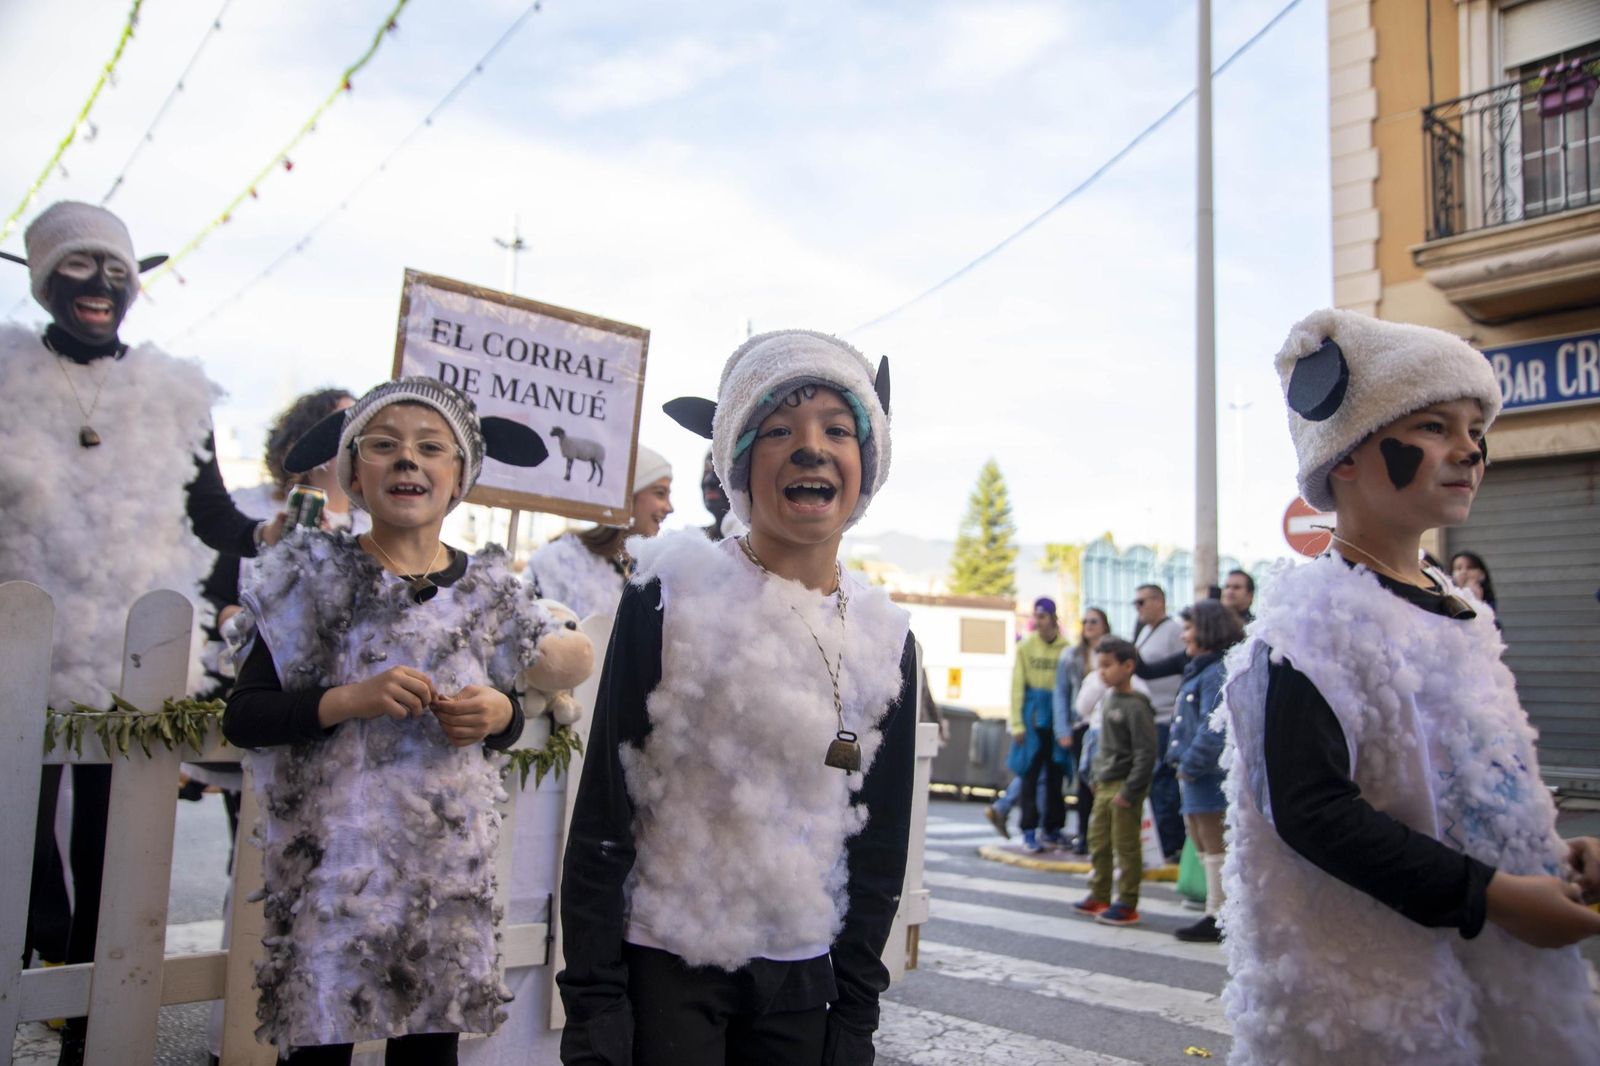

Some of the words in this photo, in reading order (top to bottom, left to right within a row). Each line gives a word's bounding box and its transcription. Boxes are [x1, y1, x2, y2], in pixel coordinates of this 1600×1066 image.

[429, 317, 474, 351] EL
[482, 331, 615, 384] CORRAL
[1492, 352, 1547, 404] BAR
[1556, 339, 1600, 398] CR
[437, 360, 482, 395] DE
[489, 372, 607, 420] MANUÉ
